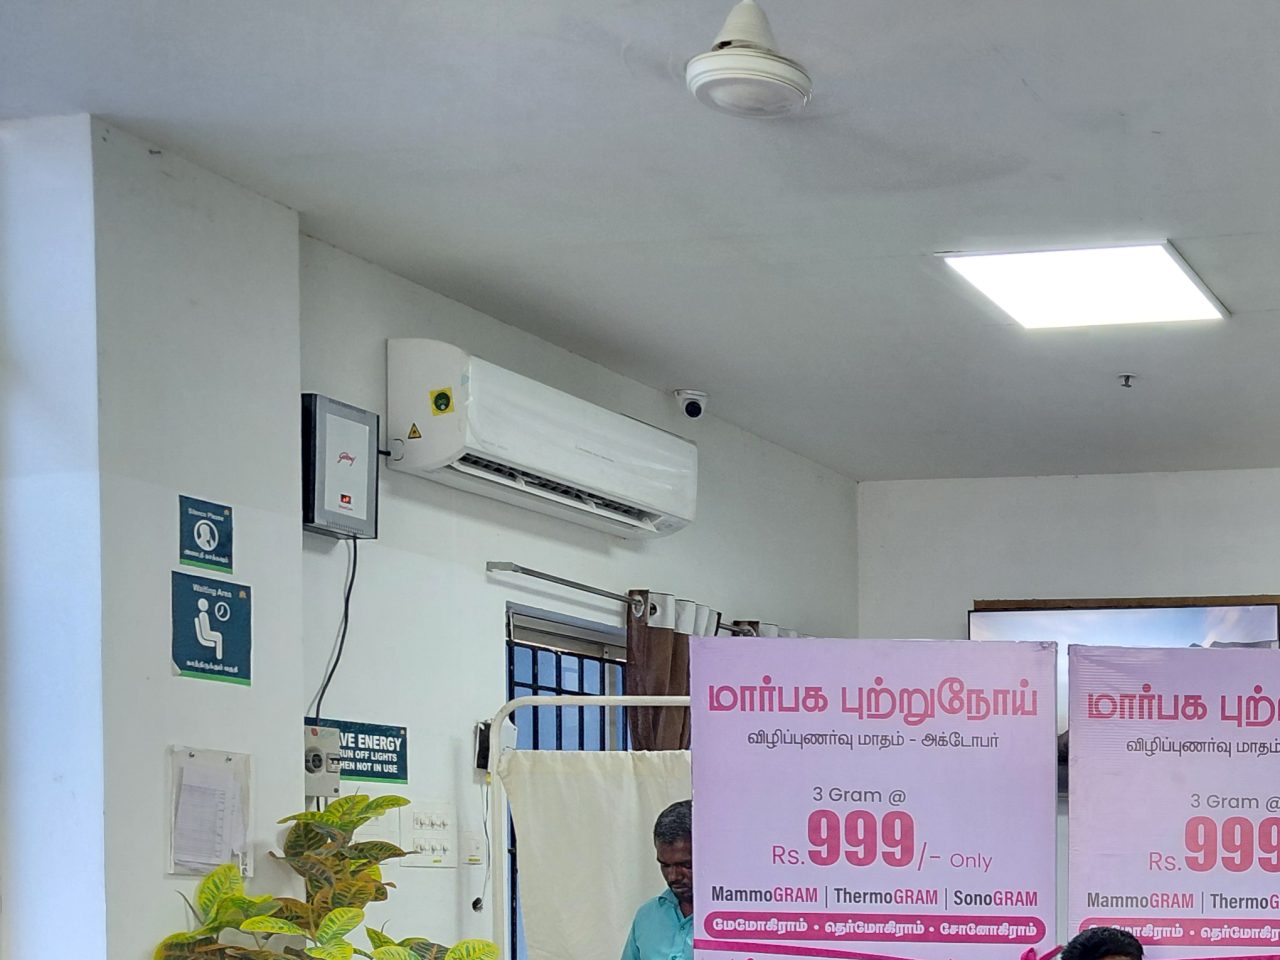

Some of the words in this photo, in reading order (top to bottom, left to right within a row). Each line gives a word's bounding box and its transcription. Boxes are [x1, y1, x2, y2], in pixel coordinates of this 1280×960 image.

[708, 675, 829, 713] மார்பக
[841, 676, 1038, 726] புற்றுநோய்
[1087, 684, 1208, 721] மார்பக
[358, 734, 402, 751] ENERGY
[747, 729, 854, 750] விழிப்புணர்வு
[858, 731, 905, 750] மாதம்
[921, 732, 1000, 750] அக்டோபர்
[1126, 737, 1232, 757] விழிப்புணர்வு
[355, 751, 370, 760] OFF
[371, 752, 398, 762] LIGHTS
[339, 761, 355, 770] HEN
[357, 762, 372, 771] NOT
[374, 764, 381, 772] IN
[383, 765, 398, 774] USE
[812, 787, 823, 802] 3
[829, 788, 882, 803] Gram
[888, 790, 906, 806] @
[1191, 795, 1200, 809] 3
[1207, 795, 1260, 810] Gram
[950, 853, 993, 873] Only
[711, 886, 819, 903] MammoGRAM
[834, 887, 939, 905] ThermoGRAM
[953, 890, 1038, 908] SonoGRAM
[1087, 893, 1194, 909] MammoGRAM
[713, 918, 808, 934] மேமோகிராம்
[825, 920, 925, 936] தெர்மோகிராம்
[939, 921, 1038, 937] சோனோகிராம்
